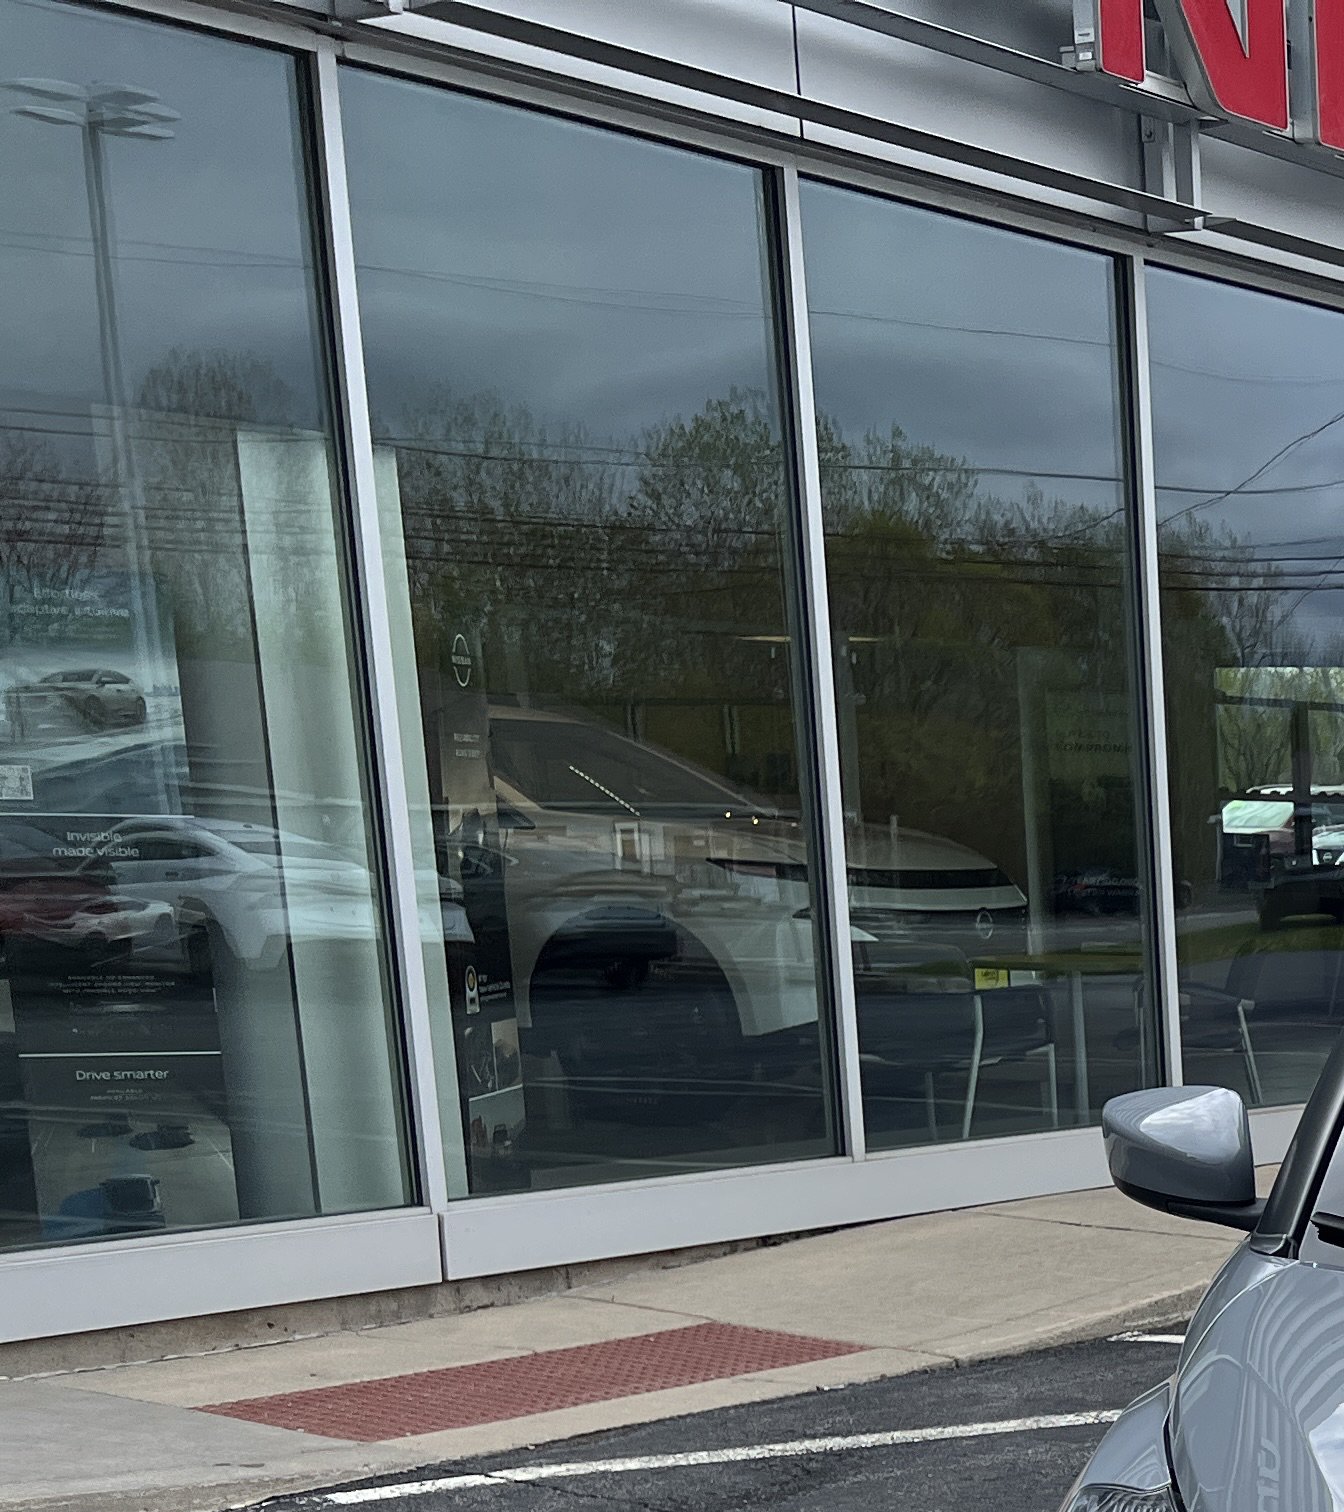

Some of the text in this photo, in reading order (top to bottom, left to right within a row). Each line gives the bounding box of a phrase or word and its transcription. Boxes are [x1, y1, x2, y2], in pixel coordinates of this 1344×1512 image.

[67, 831, 122, 843] Invisible
[52, 846, 140, 857] made visible
[76, 1070, 169, 1081] Drive smarter
